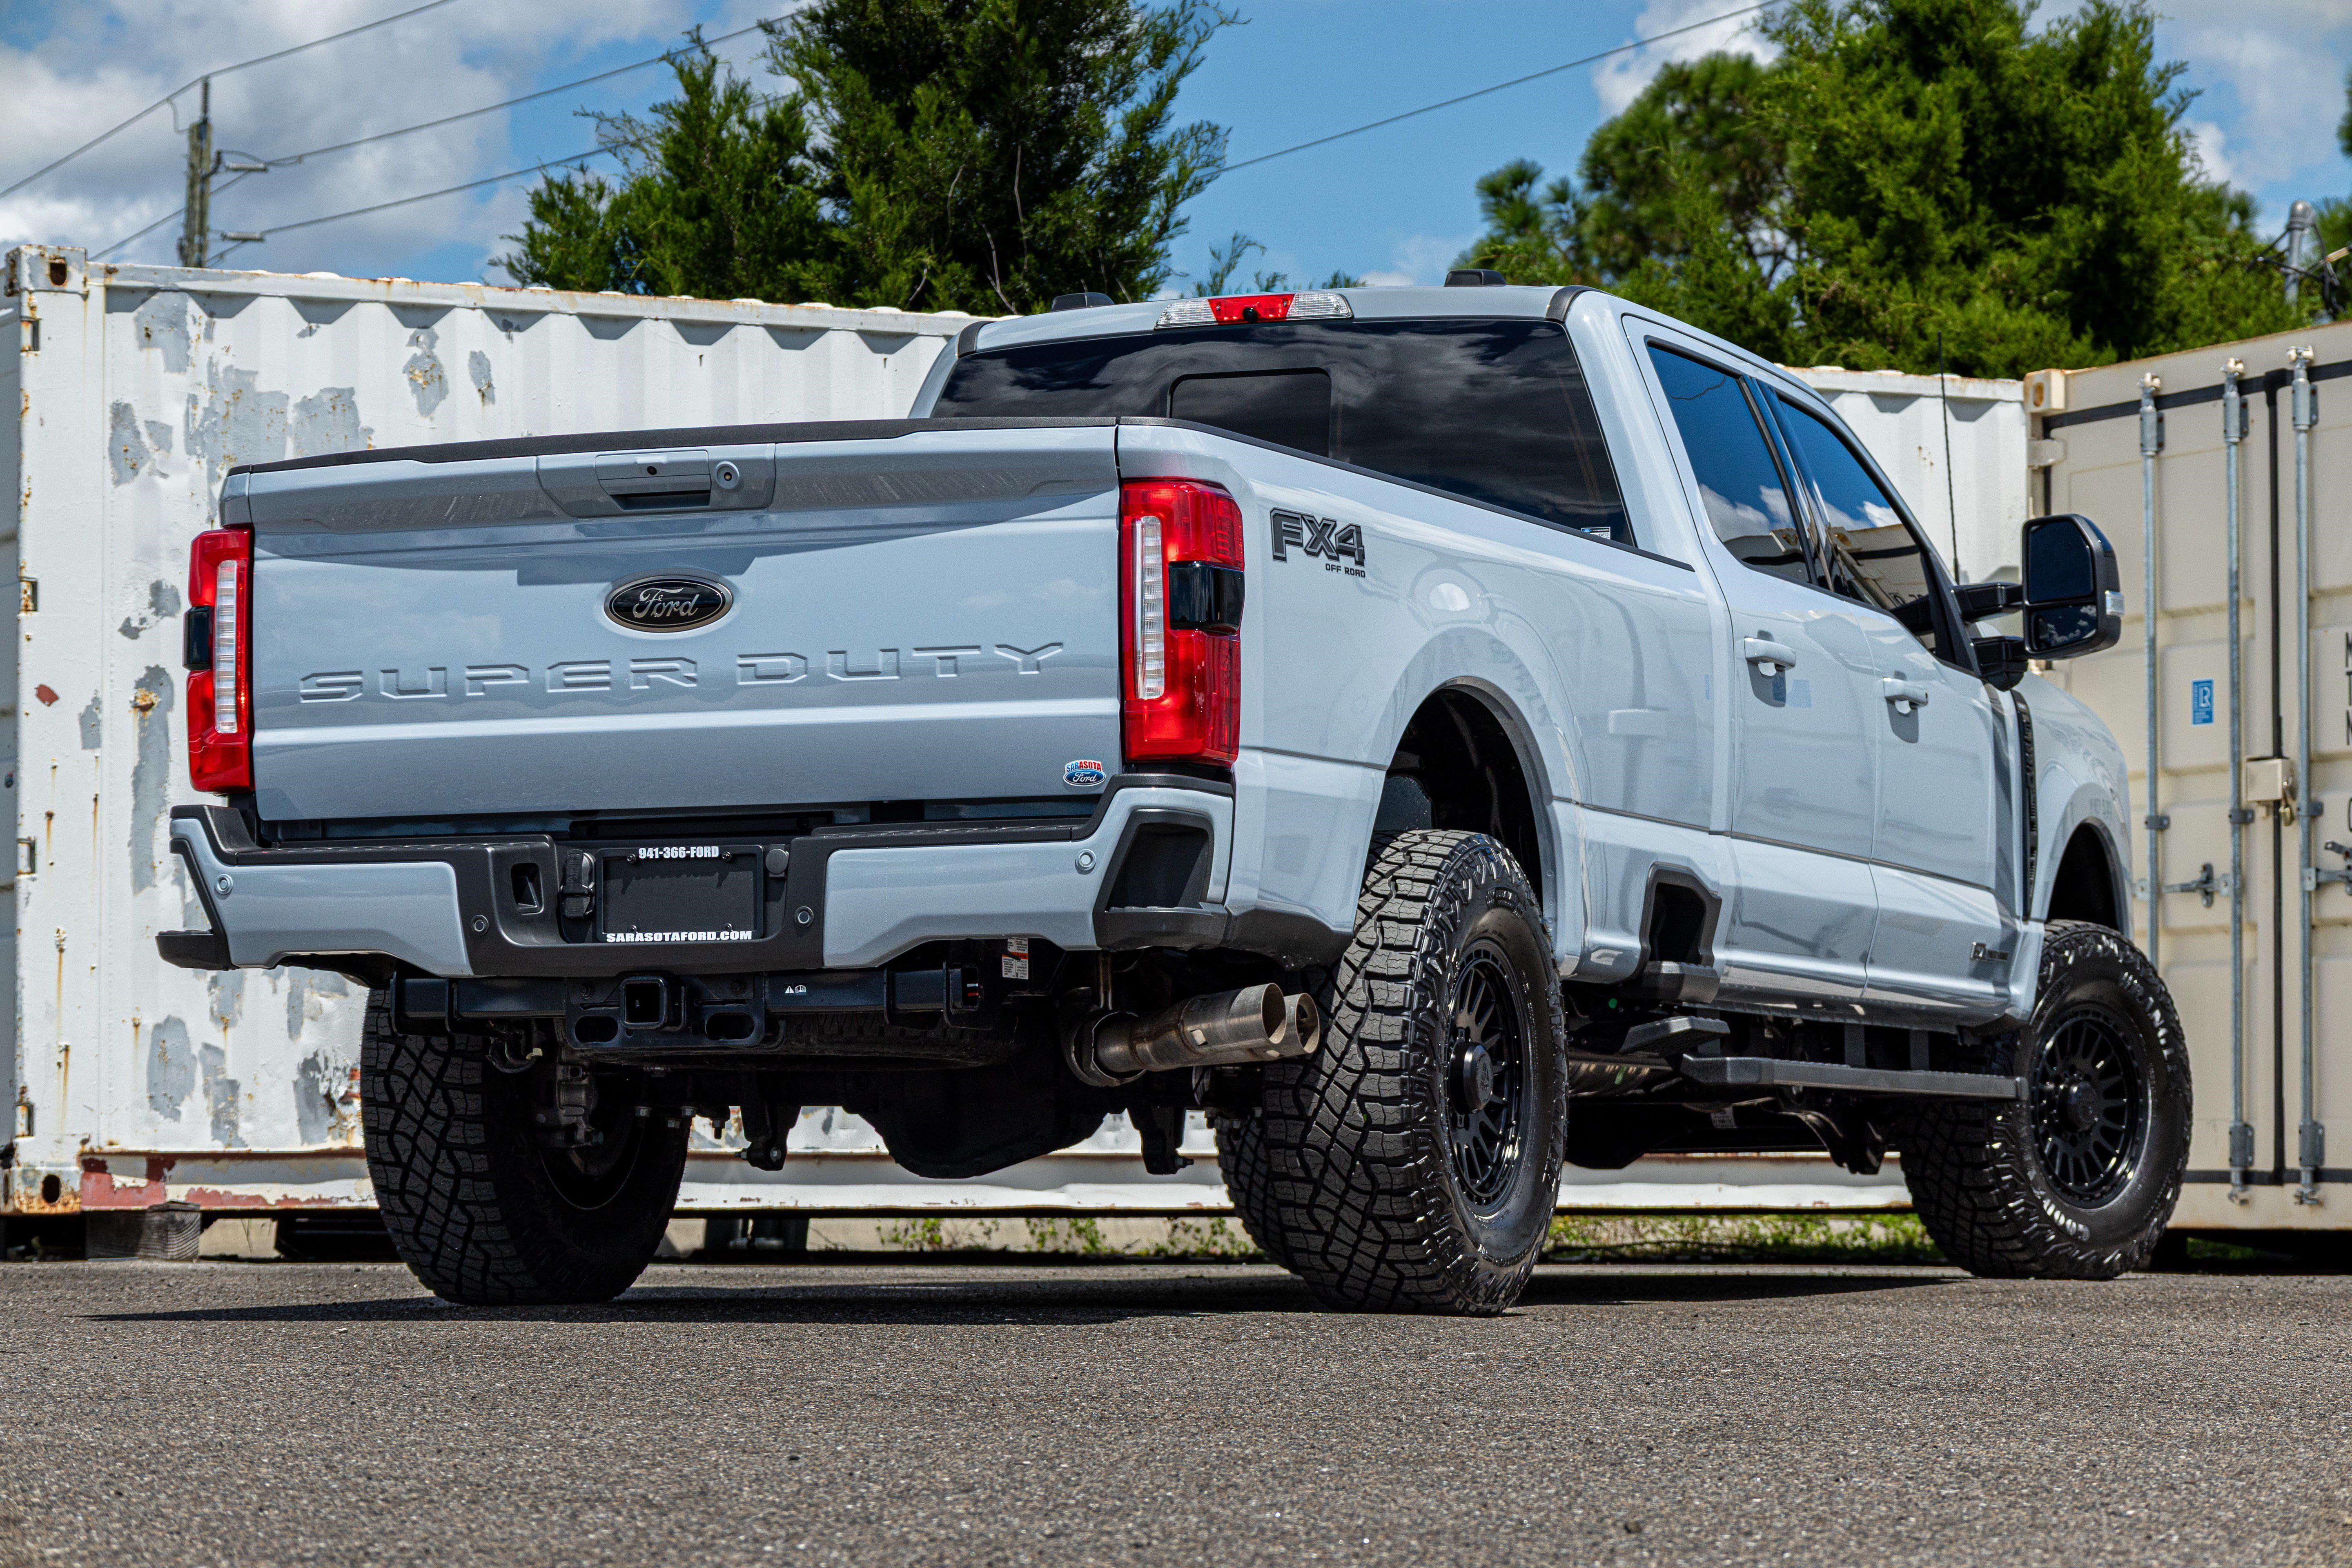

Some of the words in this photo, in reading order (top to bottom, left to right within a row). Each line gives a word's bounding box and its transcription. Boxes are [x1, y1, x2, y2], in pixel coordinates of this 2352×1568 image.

[1270, 506, 1365, 568] FX4
[1325, 563, 1342, 573] OFF
[1344, 566, 1365, 578] ROAD
[633, 587, 700, 618] Ford
[300, 657, 698, 703] SUPER
[737, 641, 1064, 685] DUTY
[1066, 761, 1102, 772] SARASOTA
[1072, 771, 1097, 782] Ford
[639, 846, 719, 859] 941-366-FORD
[606, 931, 752, 943] SARASOTAFORD.COM
